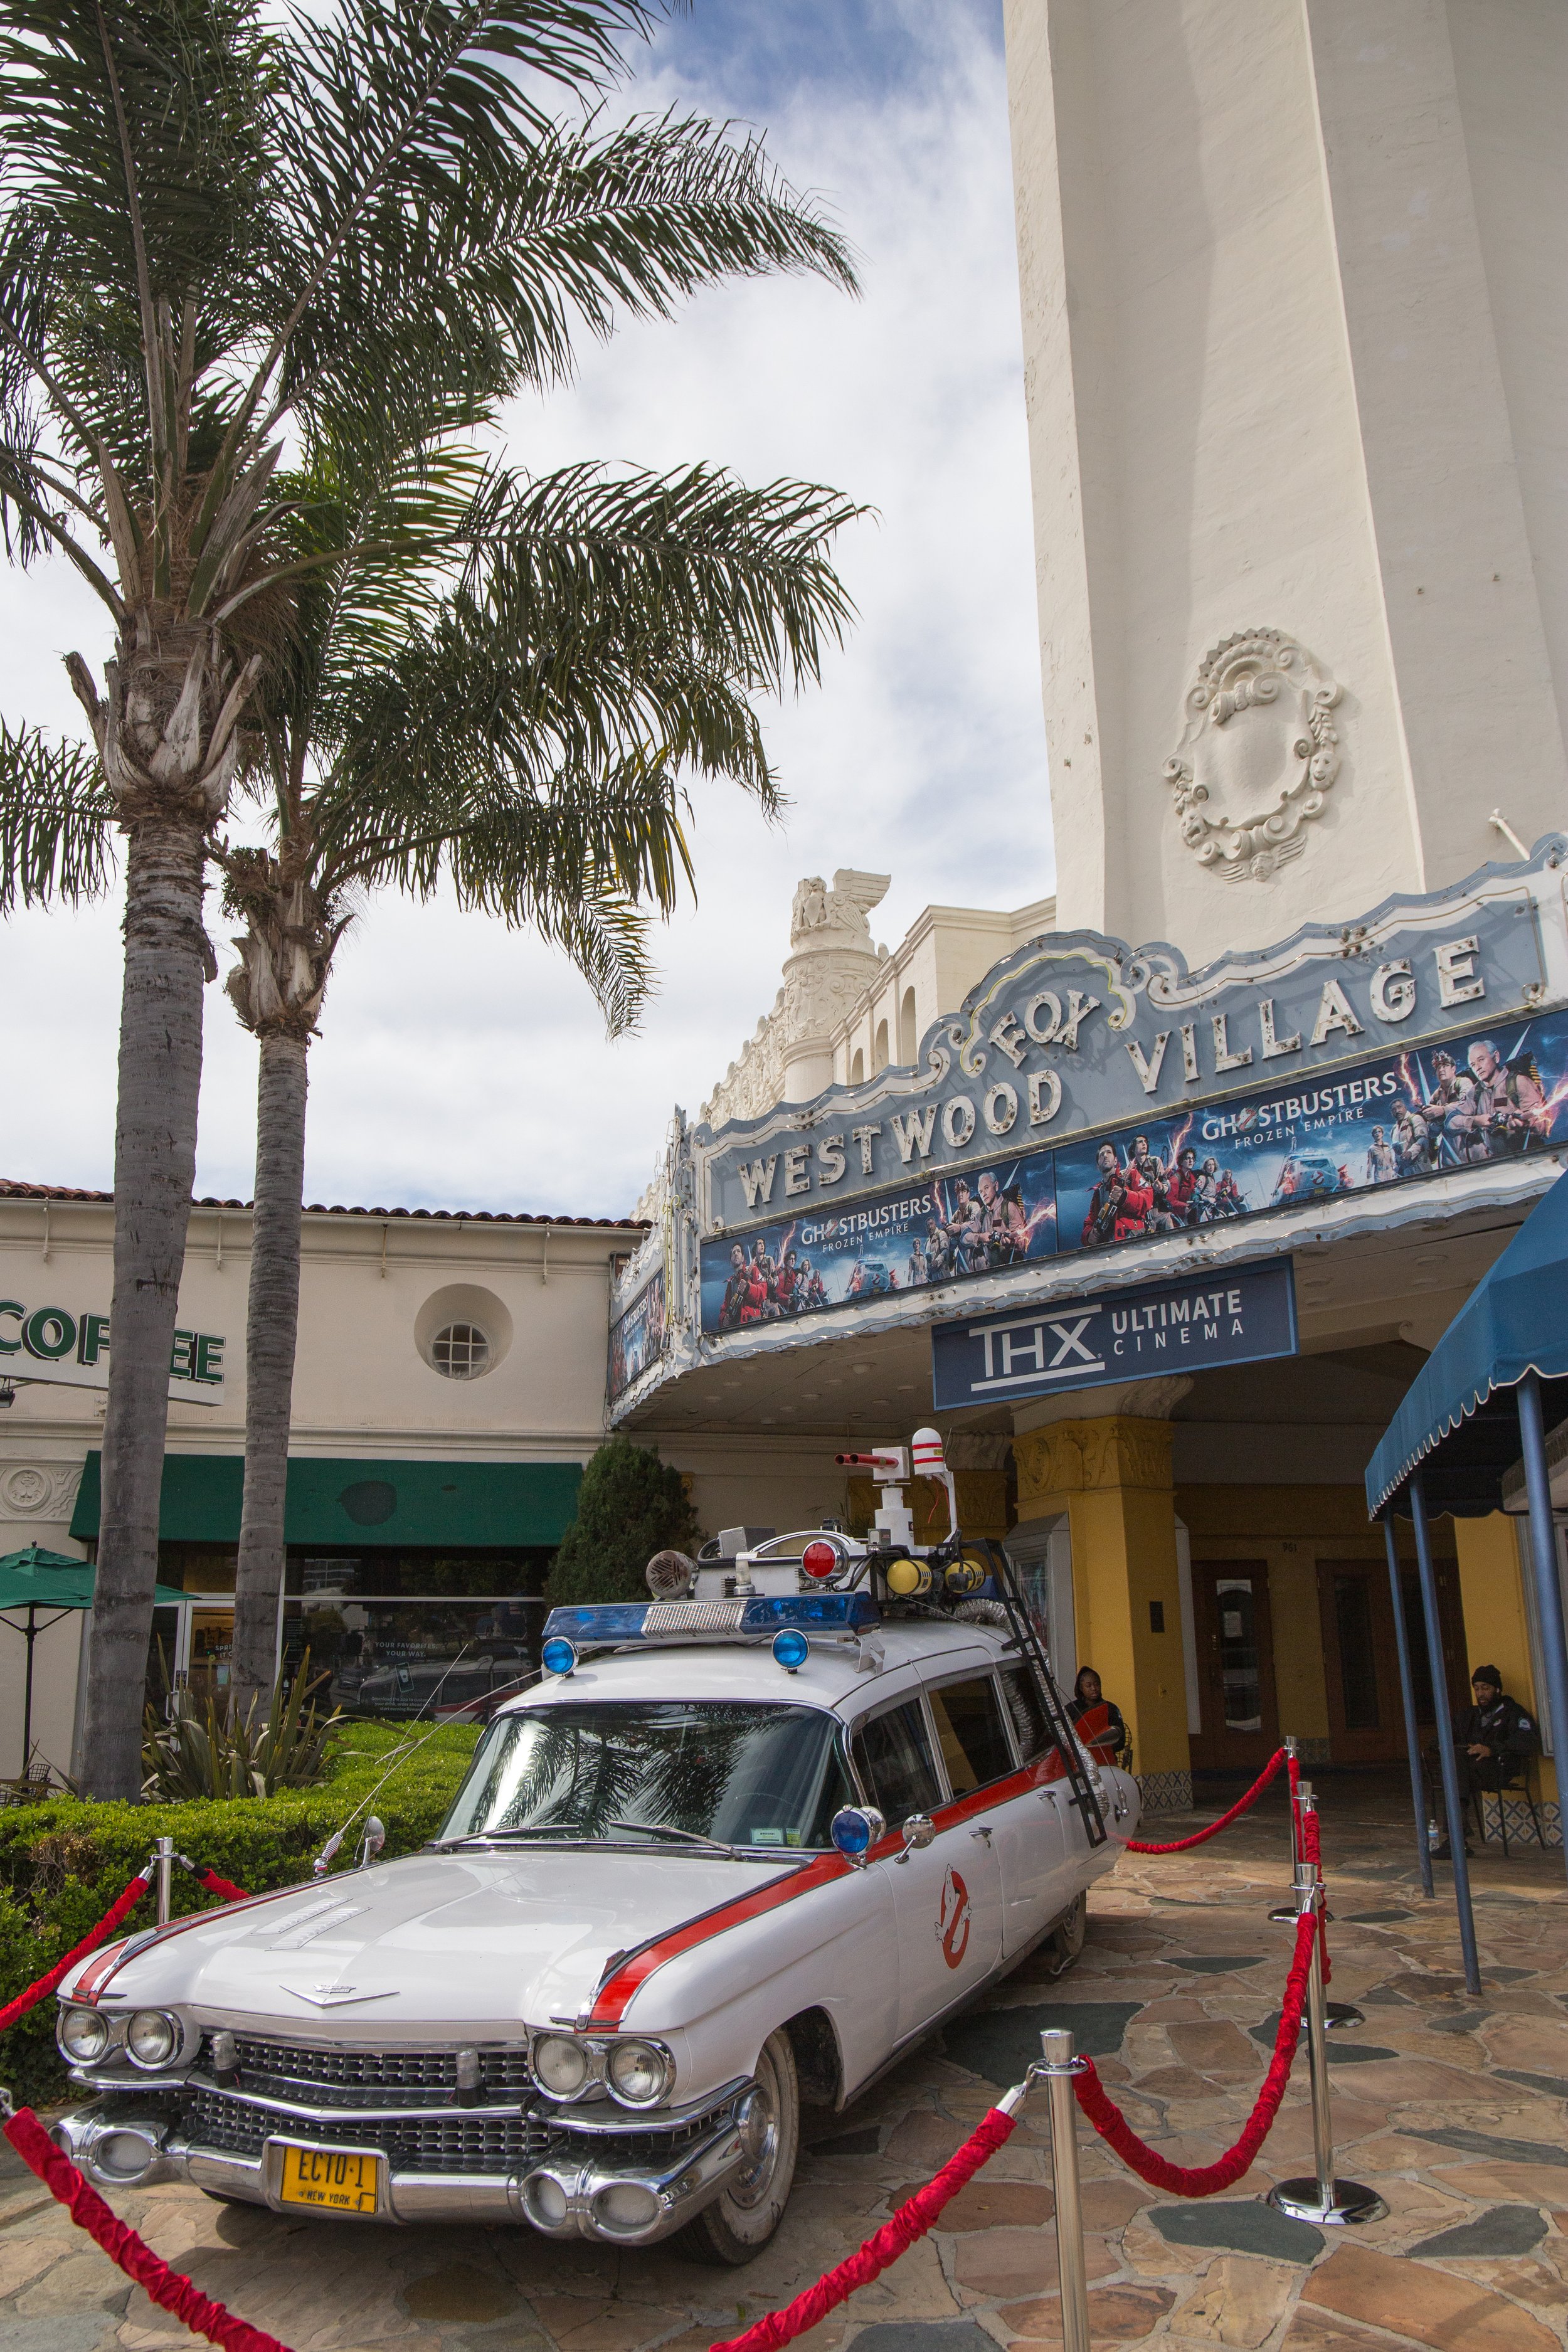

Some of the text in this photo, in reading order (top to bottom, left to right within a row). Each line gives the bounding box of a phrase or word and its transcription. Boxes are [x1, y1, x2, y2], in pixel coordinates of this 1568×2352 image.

[988, 989, 1101, 1068] FOX
[1124, 935, 1486, 1094] VILLAGE
[1202, 1071, 1397, 1141] GHOSTBUSTERS
[1235, 1108, 1364, 1149] FROZEN EMPIRE
[736, 1069, 1062, 1208] WESTWOOD
[802, 1194, 931, 1245] GHOSTBUSTERS
[822, 1222, 909, 1253] FROZEN EMPIRE
[0, 1300, 226, 1384] COFEE
[968, 1303, 1103, 1378] THX
[1111, 1289, 1242, 1335] ULTIMATE
[1113, 1318, 1244, 1355] CINEMA
[307, 2191, 351, 2205] NEW YORK
